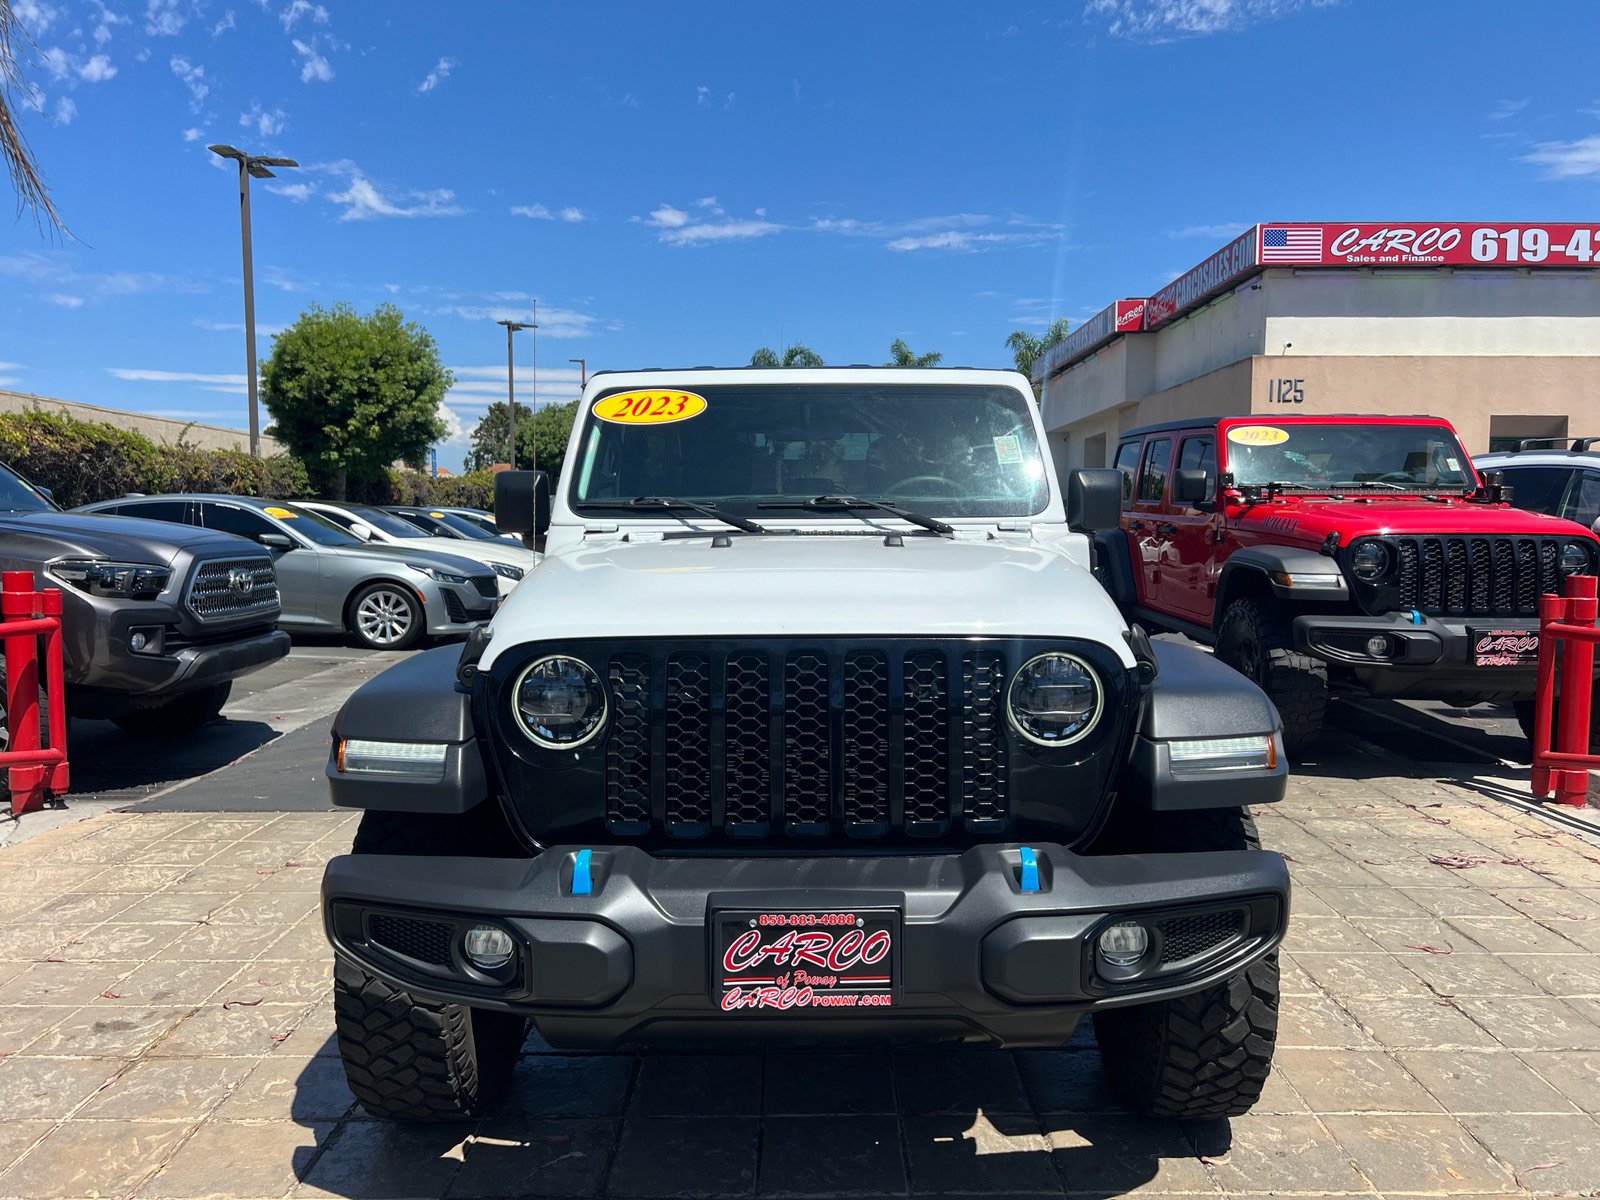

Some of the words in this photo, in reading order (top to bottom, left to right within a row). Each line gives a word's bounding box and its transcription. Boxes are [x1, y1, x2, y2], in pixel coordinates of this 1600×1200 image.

[1330, 227, 1461, 256] CARCO
[1470, 227, 1600, 262] 619-4
[1346, 254, 1376, 263] Sales
[1379, 254, 1399, 263] and
[1402, 254, 1445, 263] Finance
[1175, 231, 1256, 309] CARCOSALES.COM
[1117, 305, 1144, 325] CARCO
[1269, 378, 1305, 403] 1125
[611, 395, 689, 418] 2023
[1240, 430, 1279, 441] 2023
[1476, 636, 1539, 653] CARCO
[759, 913, 856, 926] 858-883-4888
[723, 929, 892, 973] CARCO
[776, 971, 791, 989] of
[793, 969, 838, 989] Poway
